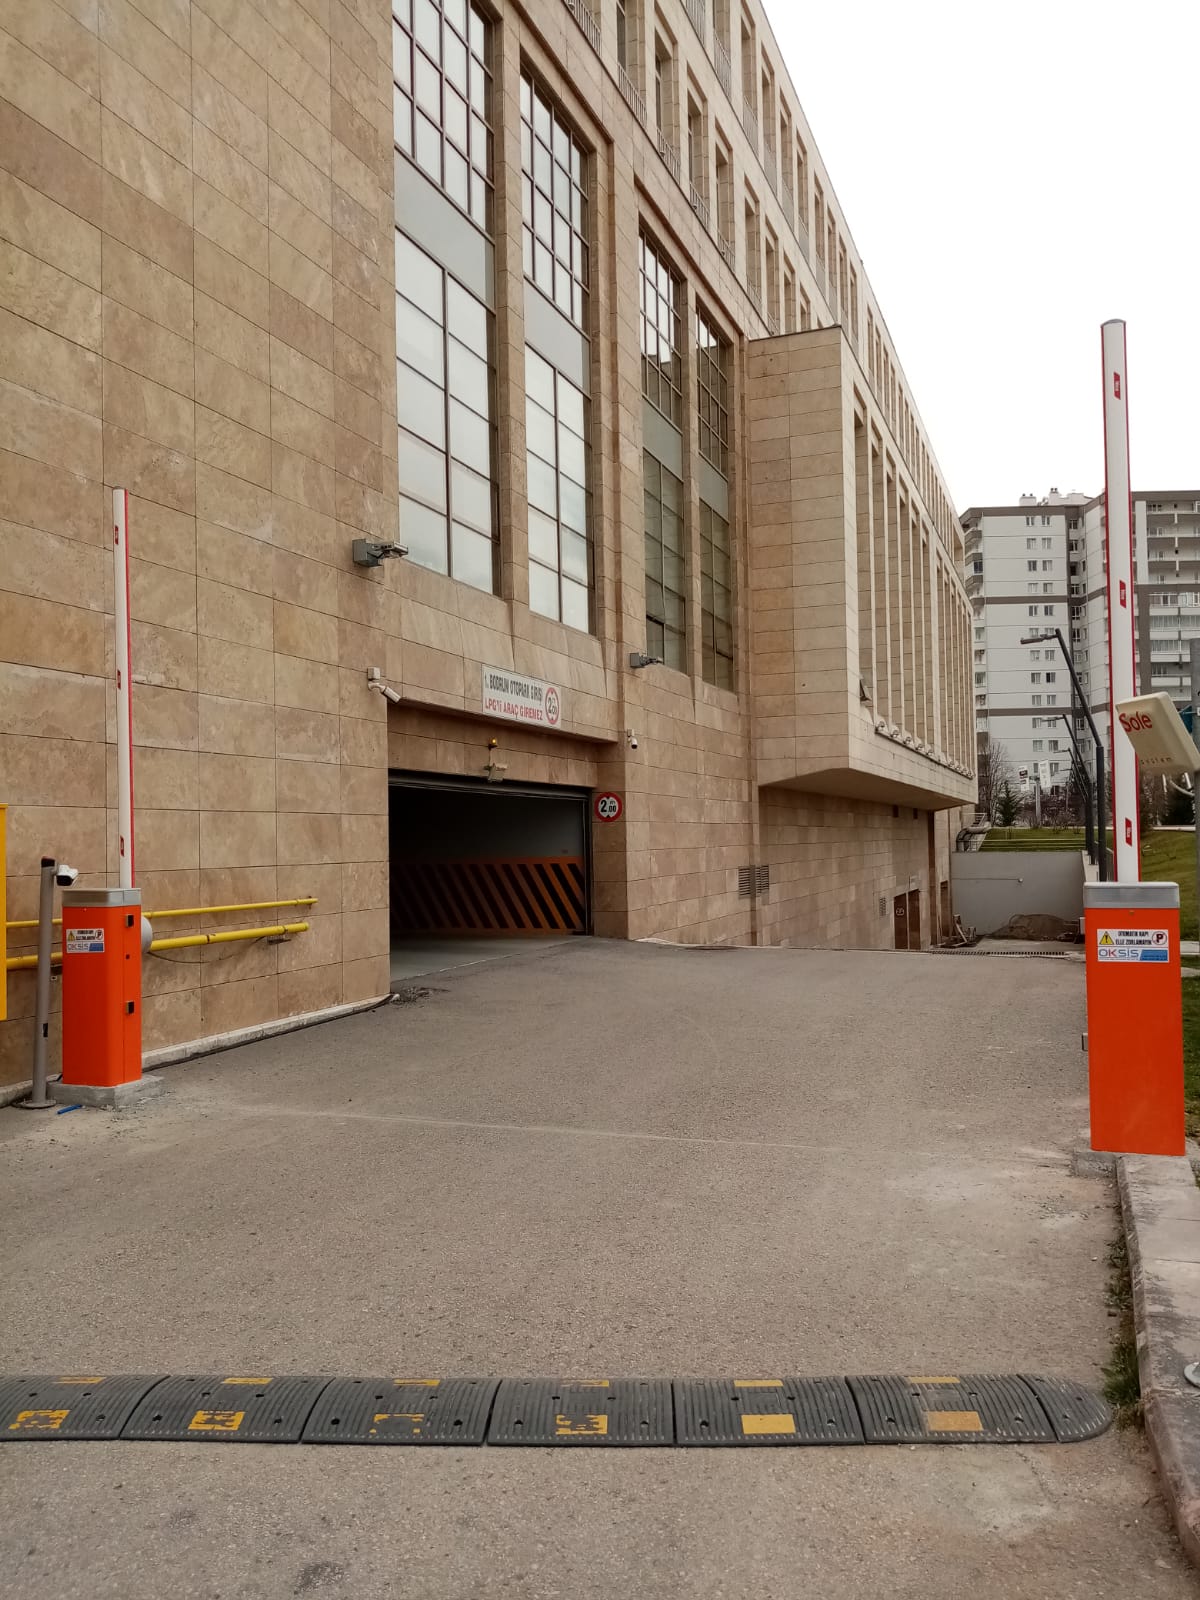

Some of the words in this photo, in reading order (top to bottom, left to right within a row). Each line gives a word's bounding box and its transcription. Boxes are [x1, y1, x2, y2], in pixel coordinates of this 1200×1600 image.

[490, 674, 509, 693] BODRUM
[510, 680, 529, 698] OTOPARK
[503, 702, 519, 718] ARAÇ
[520, 704, 543, 720] GİREMEZ
[1118, 711, 1153, 732] Sole
